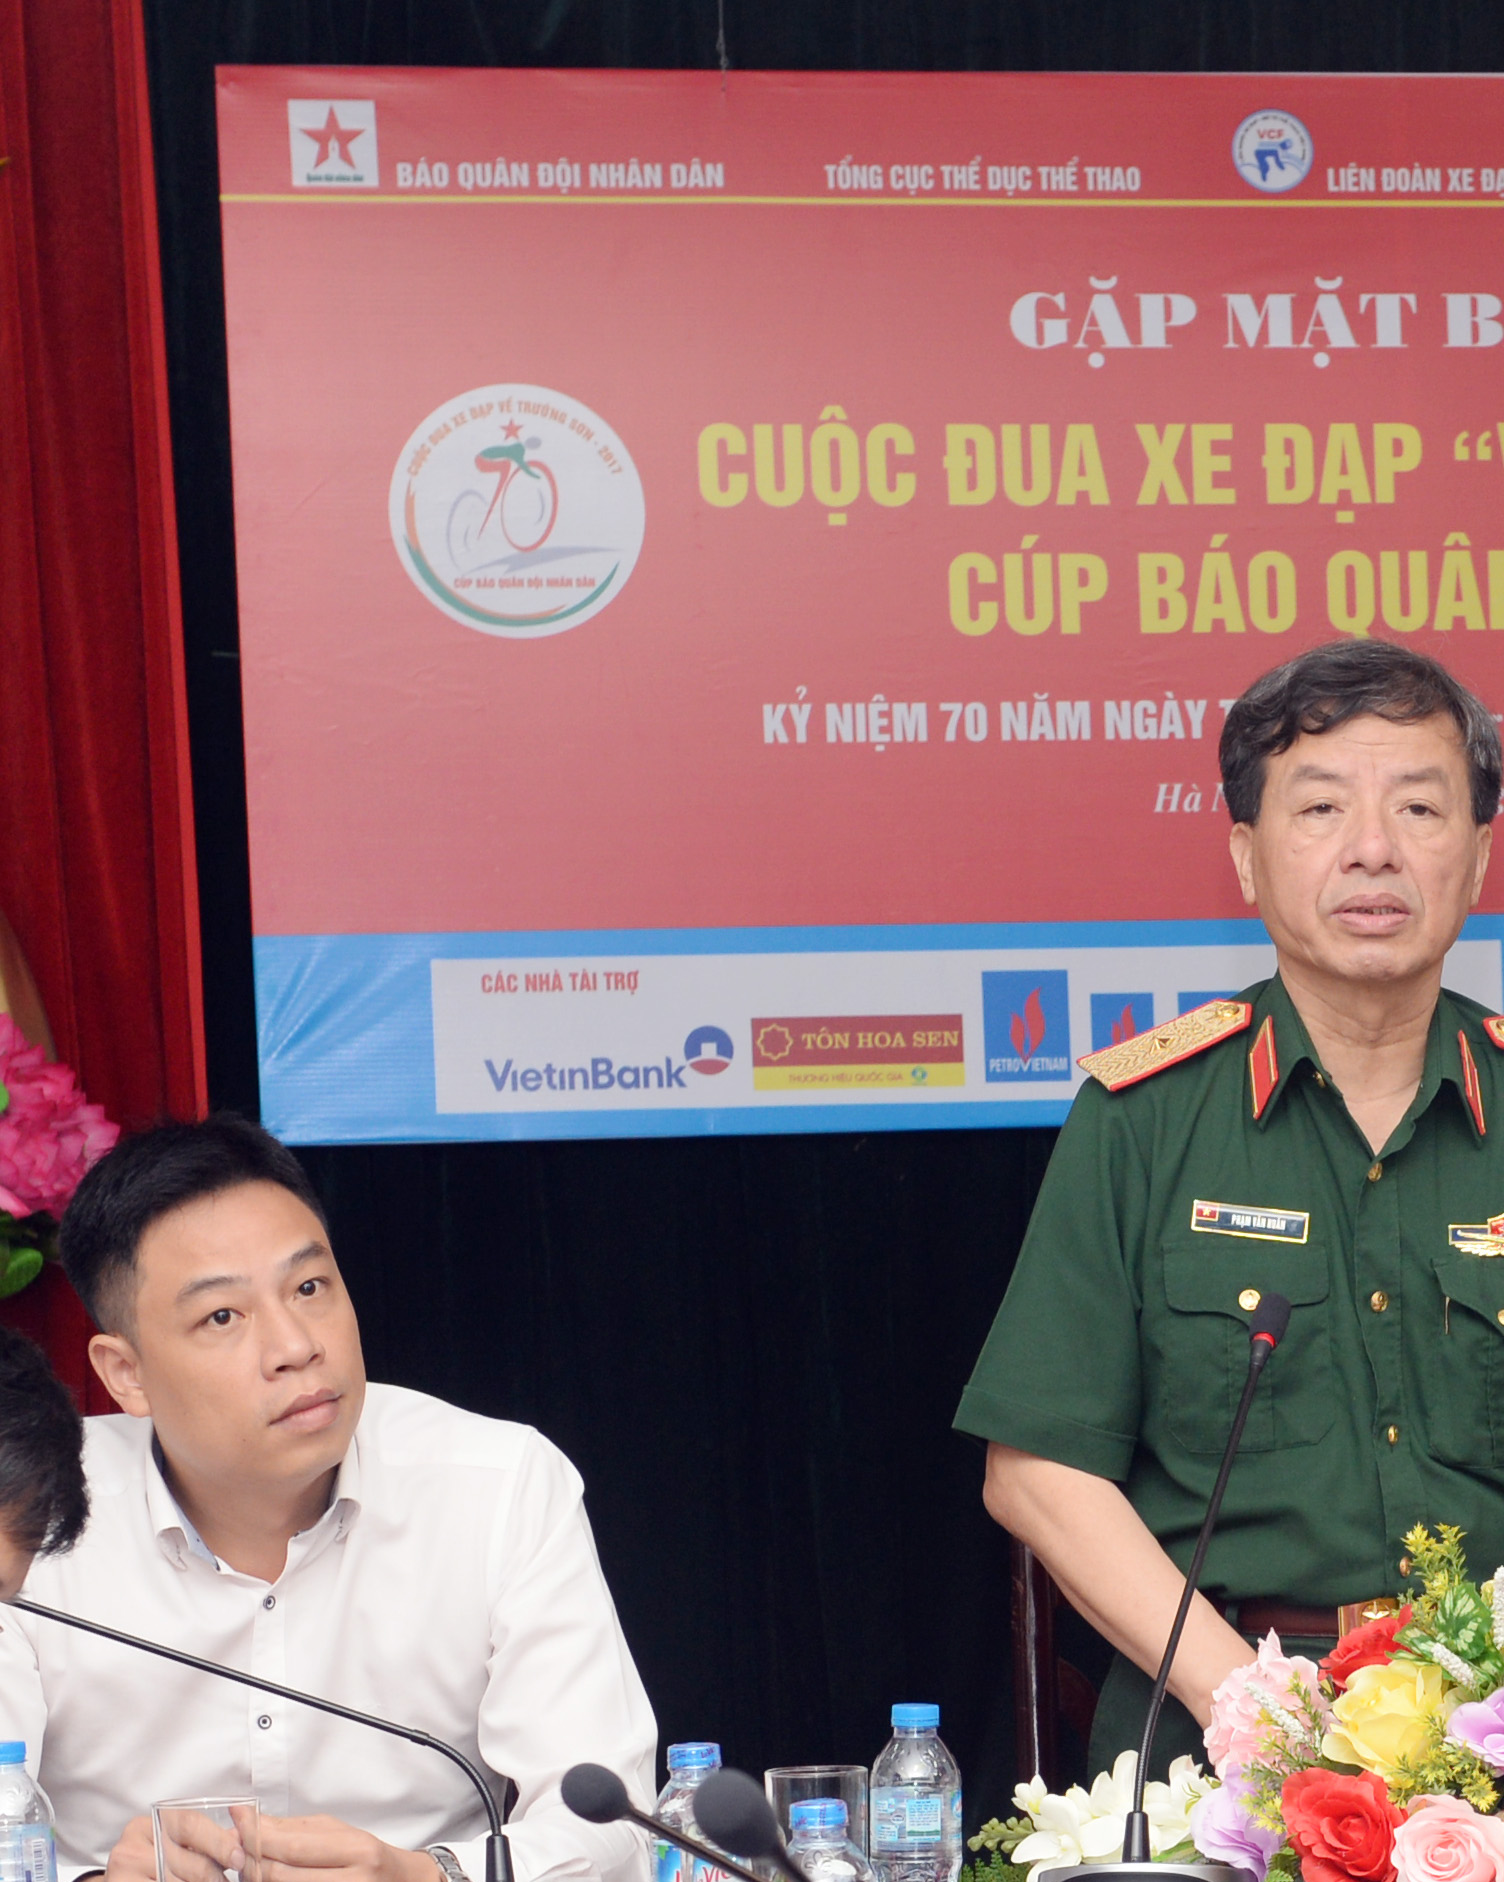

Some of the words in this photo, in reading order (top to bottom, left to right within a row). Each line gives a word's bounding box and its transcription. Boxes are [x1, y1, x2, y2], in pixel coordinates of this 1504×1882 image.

[397, 155, 449, 188] BÁO
[457, 155, 530, 188] QUÂN
[537, 155, 581, 192] ĐỘI
[589, 155, 663, 188] NHÂN
[670, 155, 724, 188] DÂN
[824, 154, 883, 191] TỔNG
[889, 164, 934, 195] CỤC
[940, 155, 981, 191] THỂ
[988, 165, 1032, 196] DỤC
[1038, 156, 1079, 192] THỂ
[1084, 165, 1141, 192] THAO
[1327, 162, 1376, 192] LIÊN
[1381, 162, 1441, 192] ĐOÀN
[1447, 167, 1474, 192] XE
[1009, 274, 1196, 370] GẶP
[1223, 274, 1416, 370] MẶT
[697, 404, 916, 526] CUỘC
[944, 421, 1110, 506] ĐUA
[1135, 421, 1236, 506] XE
[1262, 420, 1421, 524] ĐẠP
[947, 534, 1107, 636] CÚP
[1139, 533, 1295, 635] BÁO
[762, 685, 812, 744] KỶ
[825, 693, 928, 753] NIỆM
[939, 702, 988, 743] 70
[1000, 692, 1092, 742] NĂM
[1104, 691, 1208, 740] NGÀY
[1154, 783, 1201, 813] Hà
[481, 969, 518, 994] CÁC
[525, 969, 563, 993] NHÀ
[569, 968, 597, 992] TÀI
[604, 969, 639, 996] TRỢ
[802, 1026, 849, 1049] TÔN
[857, 1031, 906, 1048] HOA
[913, 1030, 959, 1047] SEN
[484, 1055, 687, 1092] VietinBank
[989, 1057, 1068, 1072] PETROVIETNAM
